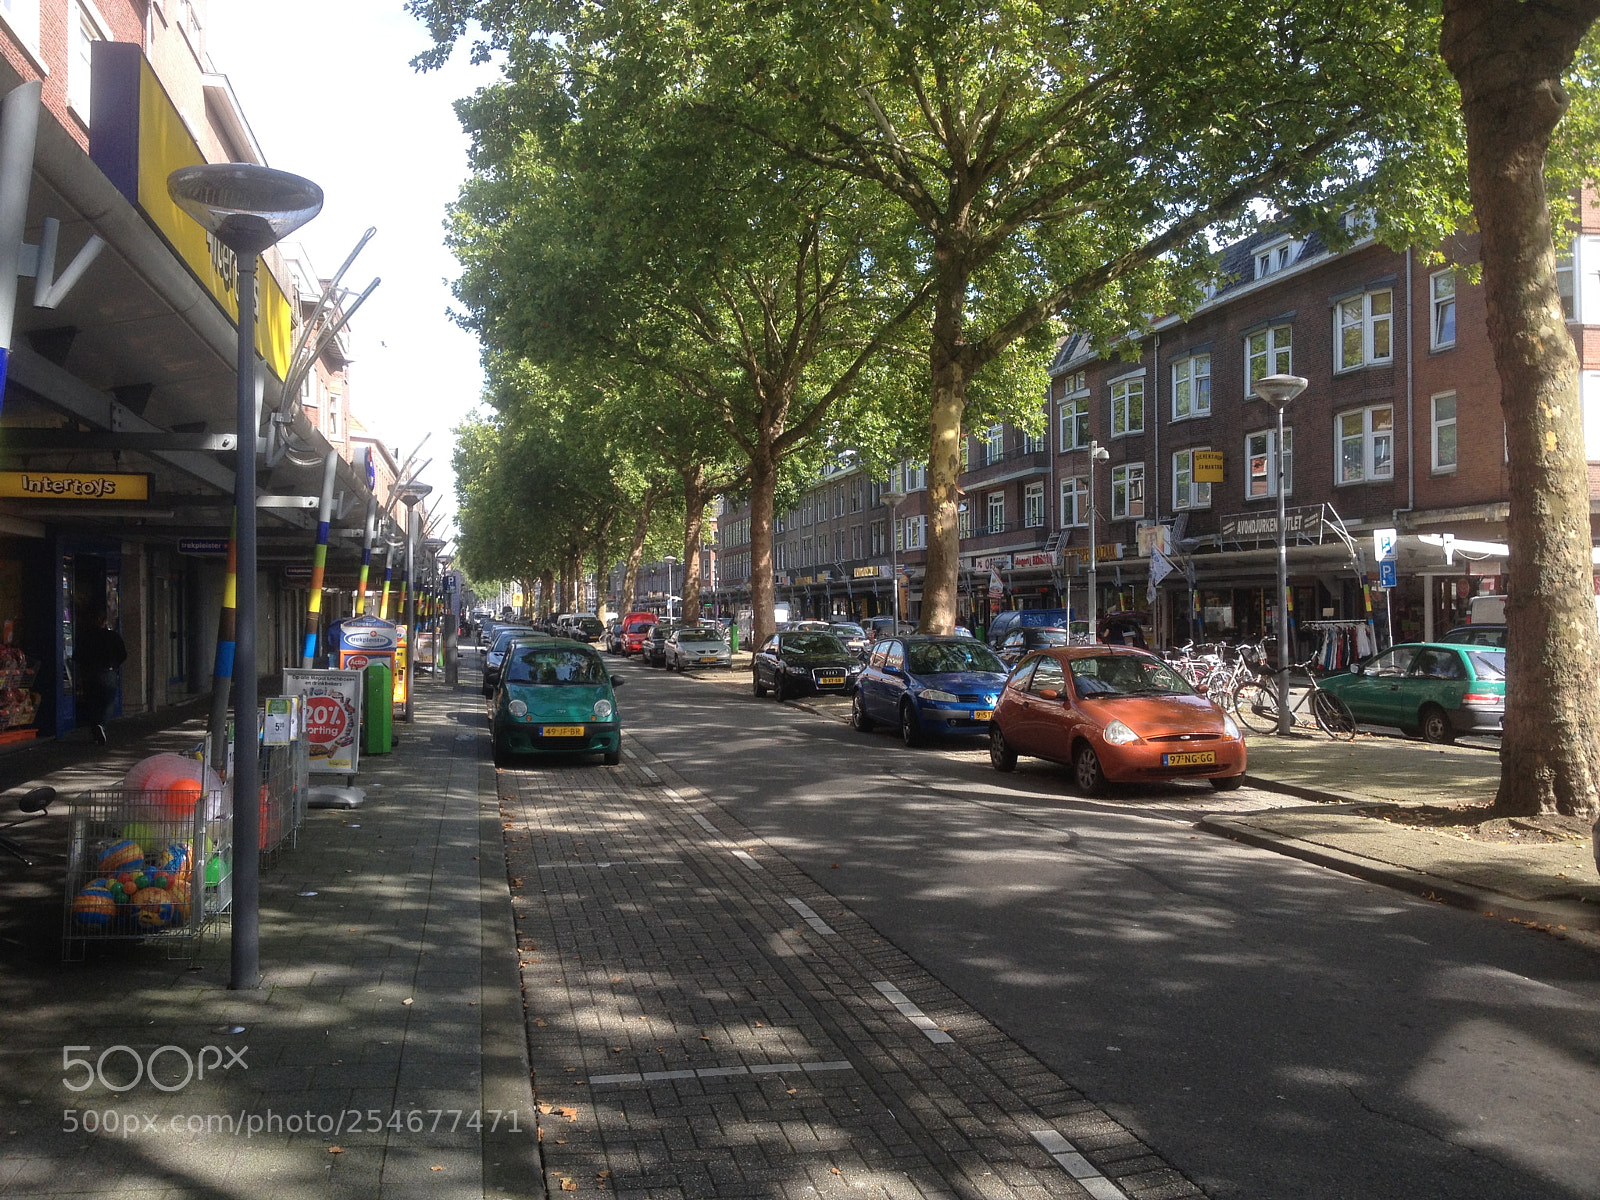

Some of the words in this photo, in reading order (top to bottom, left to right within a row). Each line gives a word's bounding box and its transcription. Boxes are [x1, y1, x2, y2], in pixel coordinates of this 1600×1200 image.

[22, 475, 116, 497] Intertoys
[1236, 518, 1278, 535] AVONDJURKEN
[1284, 515, 1303, 531] UTLET
[1383, 565, 1391, 578] P
[306, 706, 341, 724] 20%
[307, 726, 339, 736] orting
[1169, 753, 1213, 764] 97-NG-GG
